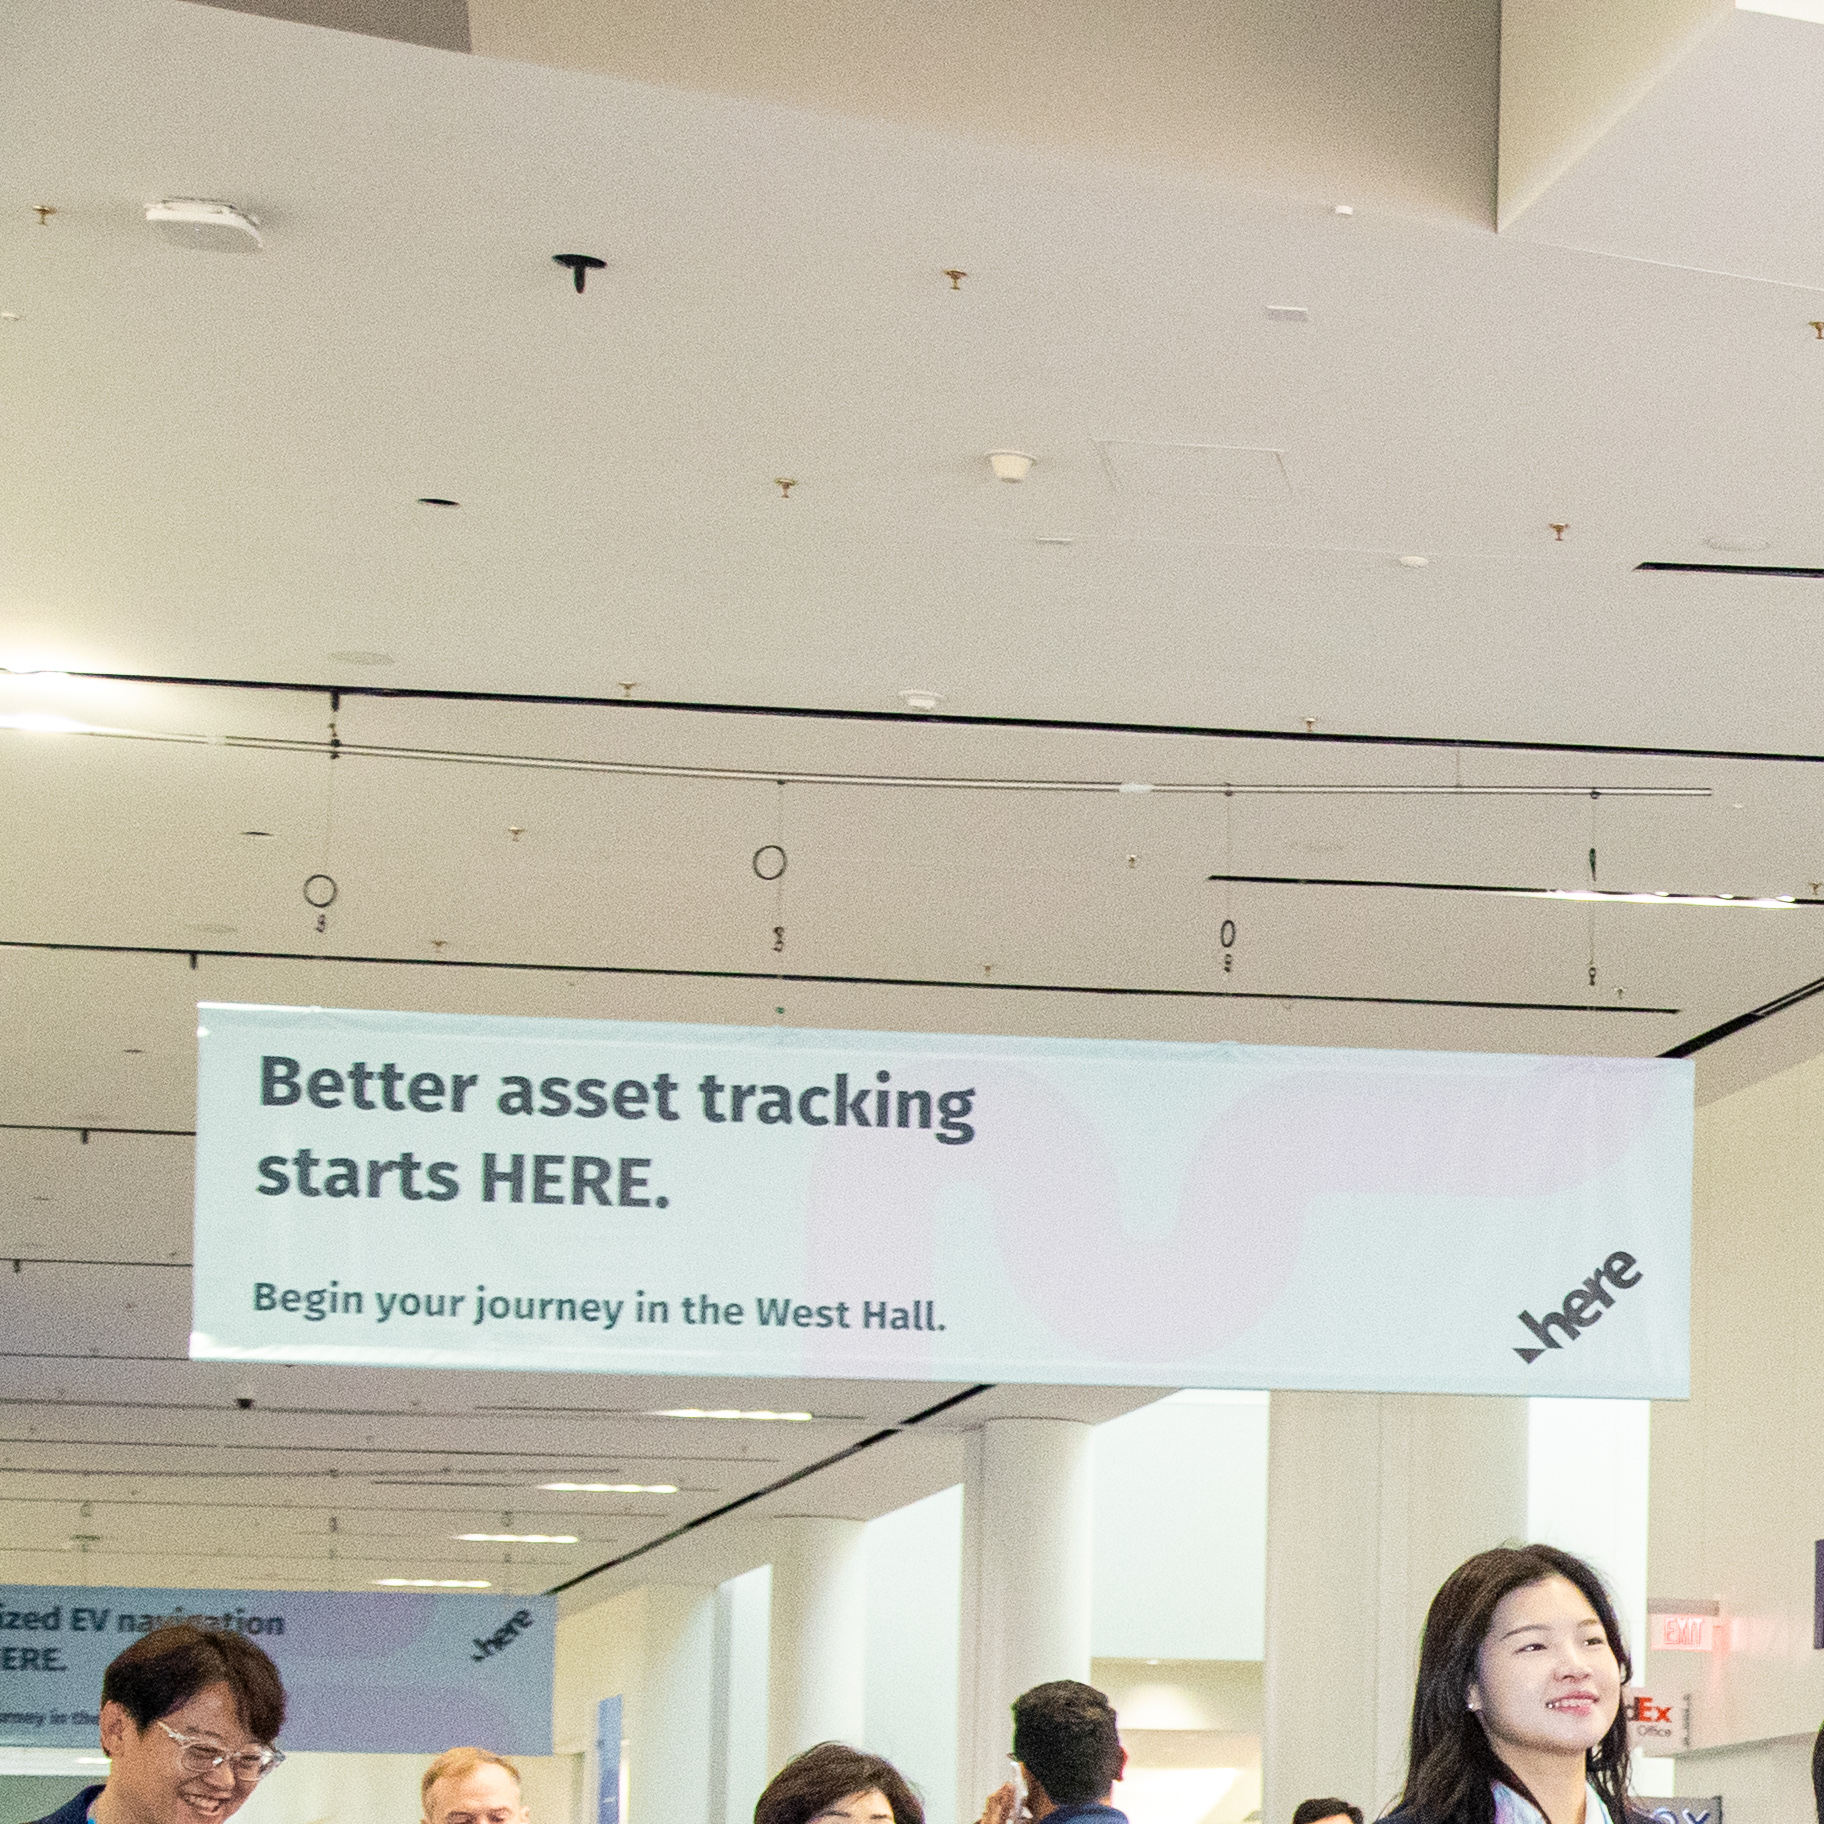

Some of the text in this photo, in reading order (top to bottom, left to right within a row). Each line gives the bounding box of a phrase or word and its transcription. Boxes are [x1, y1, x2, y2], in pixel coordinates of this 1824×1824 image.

[260, 1055, 976, 1146] Better asset tracking
[256, 1149, 669, 1209] starts HERE.
[253, 1280, 946, 1331] Begin your journey in the West Hall.
[1517, 1251, 1643, 1349] here
[71, 1608, 110, 1631] EV
[118, 1606, 285, 1635] naiation
[473, 1609, 534, 1657] here
[1664, 1618, 1704, 1645] EXIT
[1625, 1696, 1671, 1722] dEx
